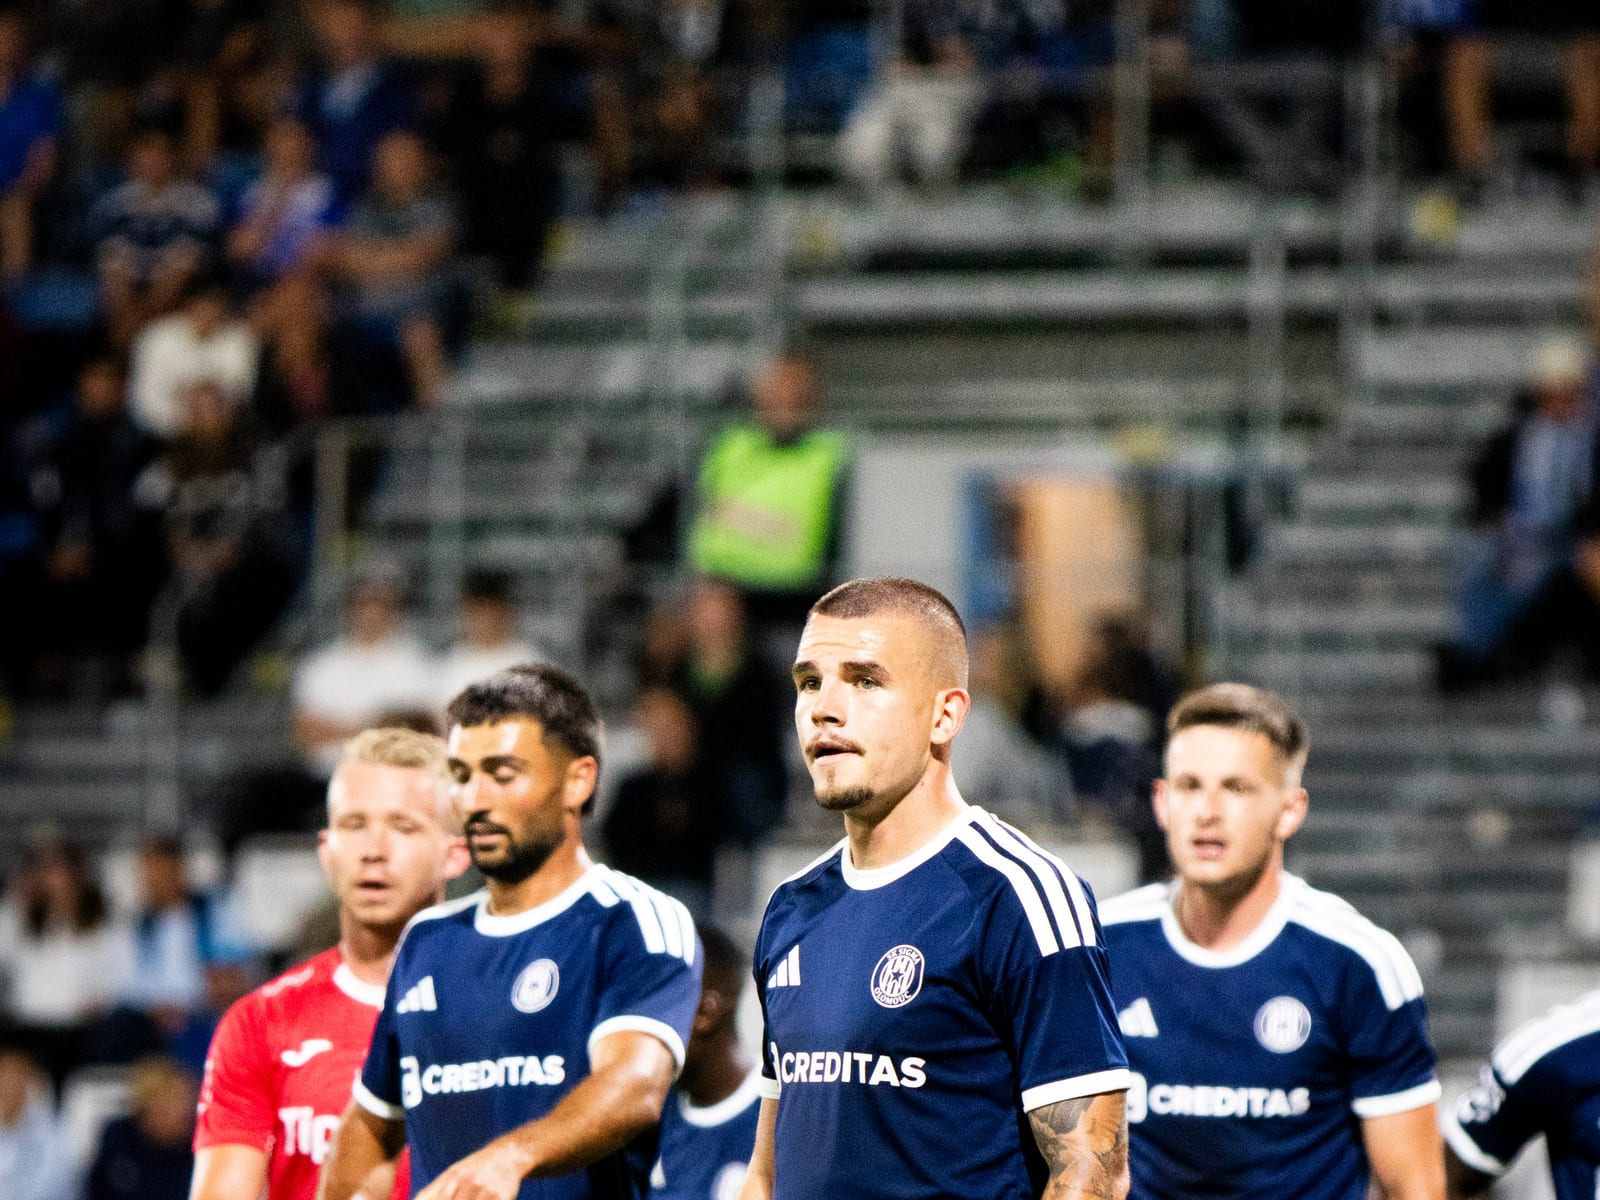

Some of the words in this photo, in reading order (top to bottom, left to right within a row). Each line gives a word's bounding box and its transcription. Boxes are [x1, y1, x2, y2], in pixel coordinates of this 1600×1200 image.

[898, 948, 920, 965] SIGMA
[874, 987, 911, 1005] OLOMOUC
[422, 1054, 565, 1094] CREDITAS
[781, 1051, 927, 1088] CREDITAS
[1148, 1083, 1311, 1118] CREDITAS
